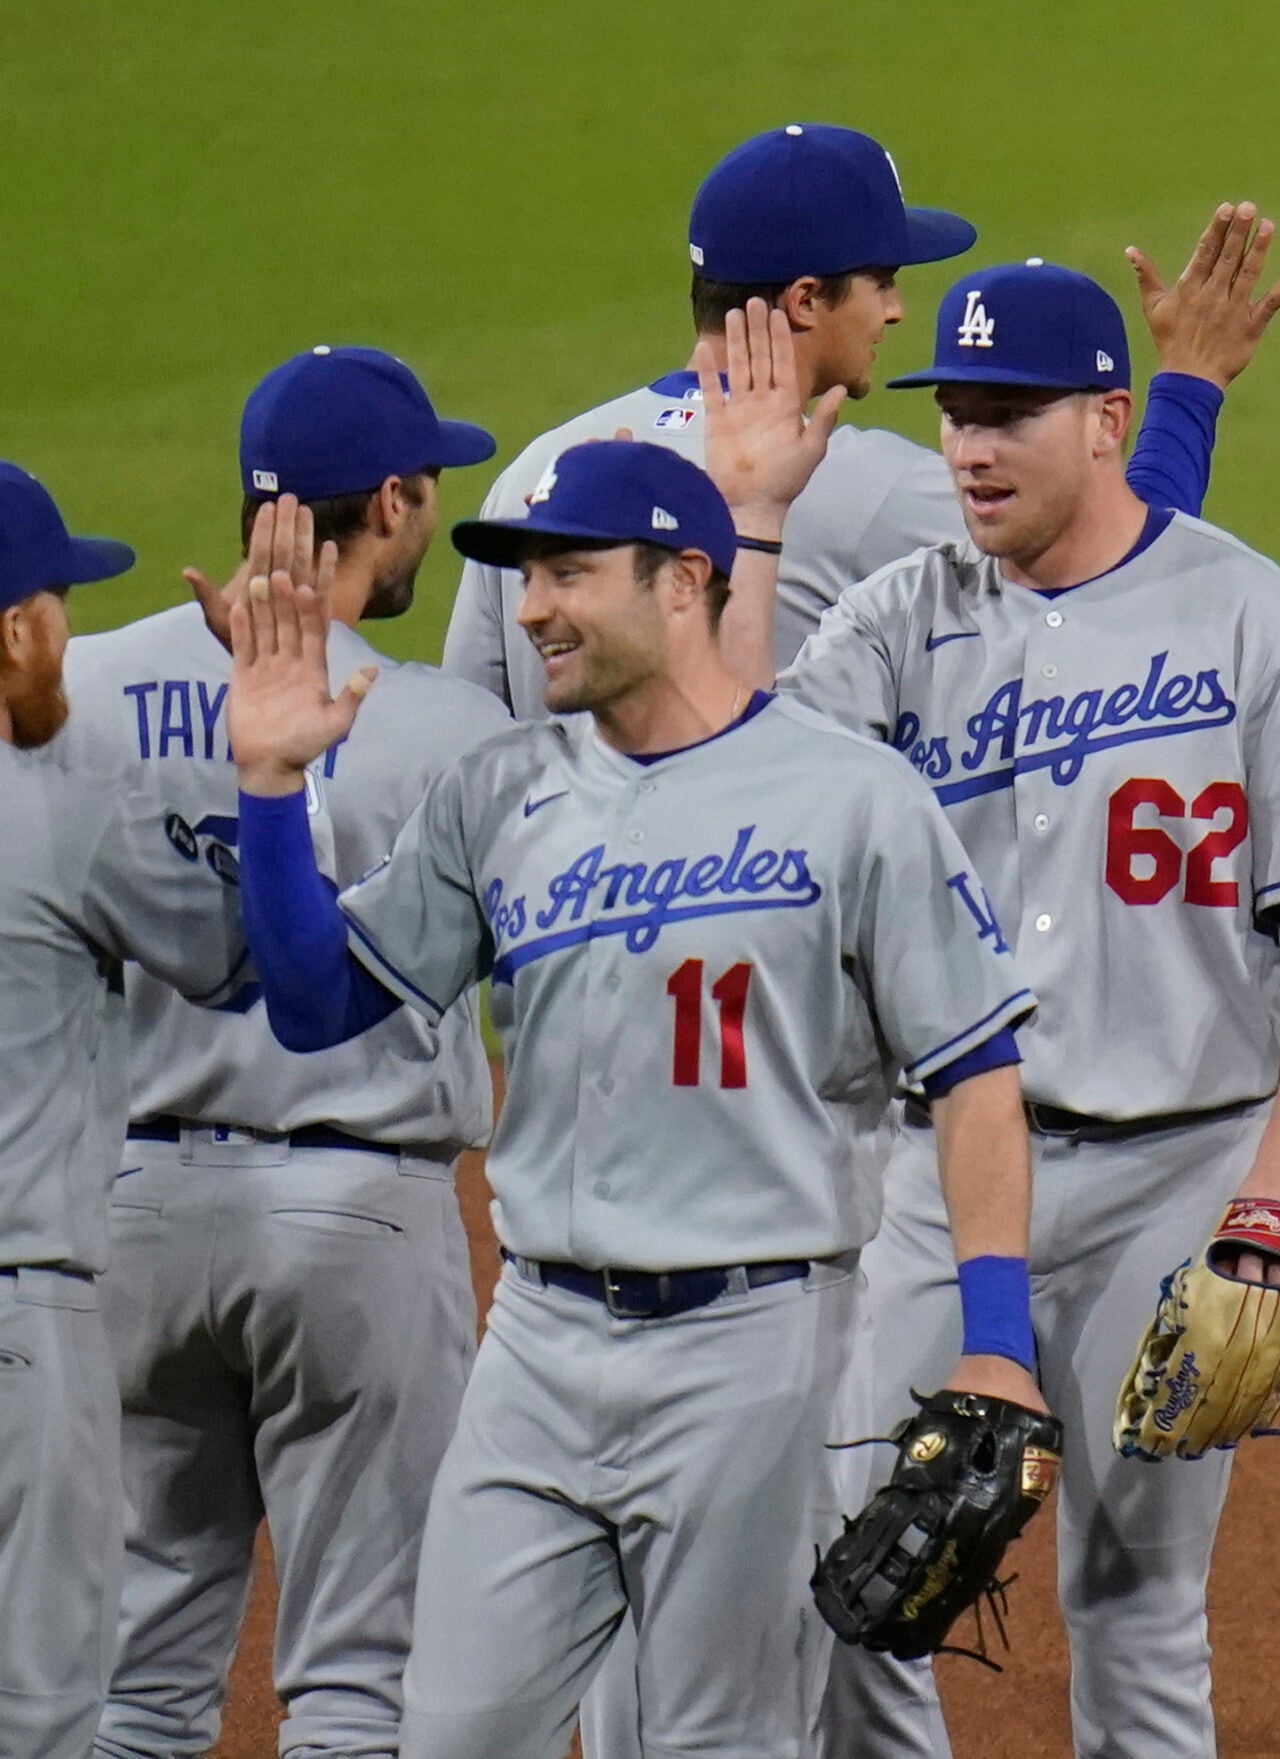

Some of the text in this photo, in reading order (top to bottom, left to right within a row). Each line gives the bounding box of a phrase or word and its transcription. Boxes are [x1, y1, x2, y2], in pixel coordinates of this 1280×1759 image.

[957, 290, 995, 348] LA
[961, 650, 1236, 786] Angeles
[536, 824, 821, 954] Angeles
[1105, 777, 1249, 908] 62
[666, 957, 753, 1090] 11
[1153, 1350, 1201, 1432] Rawlings
